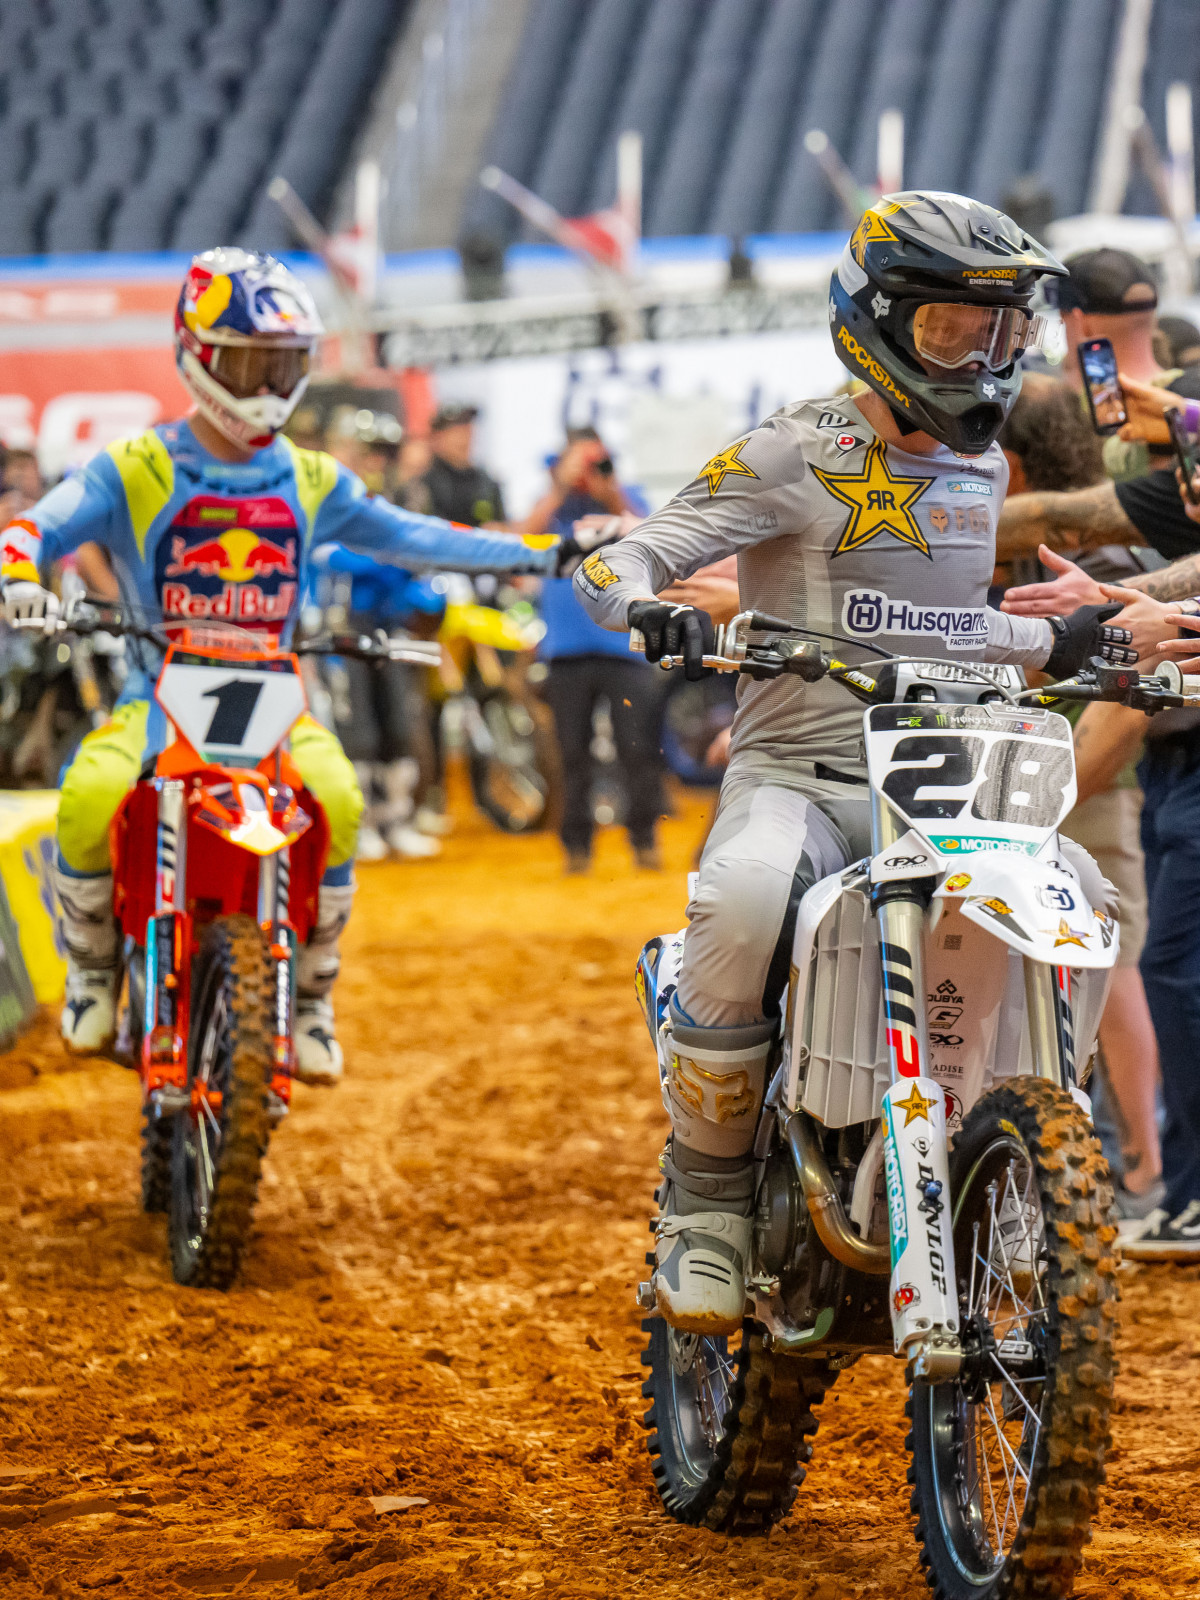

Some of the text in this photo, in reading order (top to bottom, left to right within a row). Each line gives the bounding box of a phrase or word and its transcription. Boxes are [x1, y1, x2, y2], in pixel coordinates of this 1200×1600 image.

[995, 279, 1014, 287] DRINK
[837, 325, 912, 408] ROCKSTAR
[960, 482, 992, 495] MOTOREX
[162, 581, 297, 620] Red Bull
[950, 638, 975, 646] FACTORY
[202, 677, 265, 746] 1
[1005, 706, 1032, 714] CRAIG
[882, 735, 1075, 827] 28
[960, 838, 1028, 854] MOTOREX
[932, 1063, 964, 1074] ADISE
[884, 1136, 908, 1246] MOTOREX
[917, 1161, 948, 1296] DNLOP
